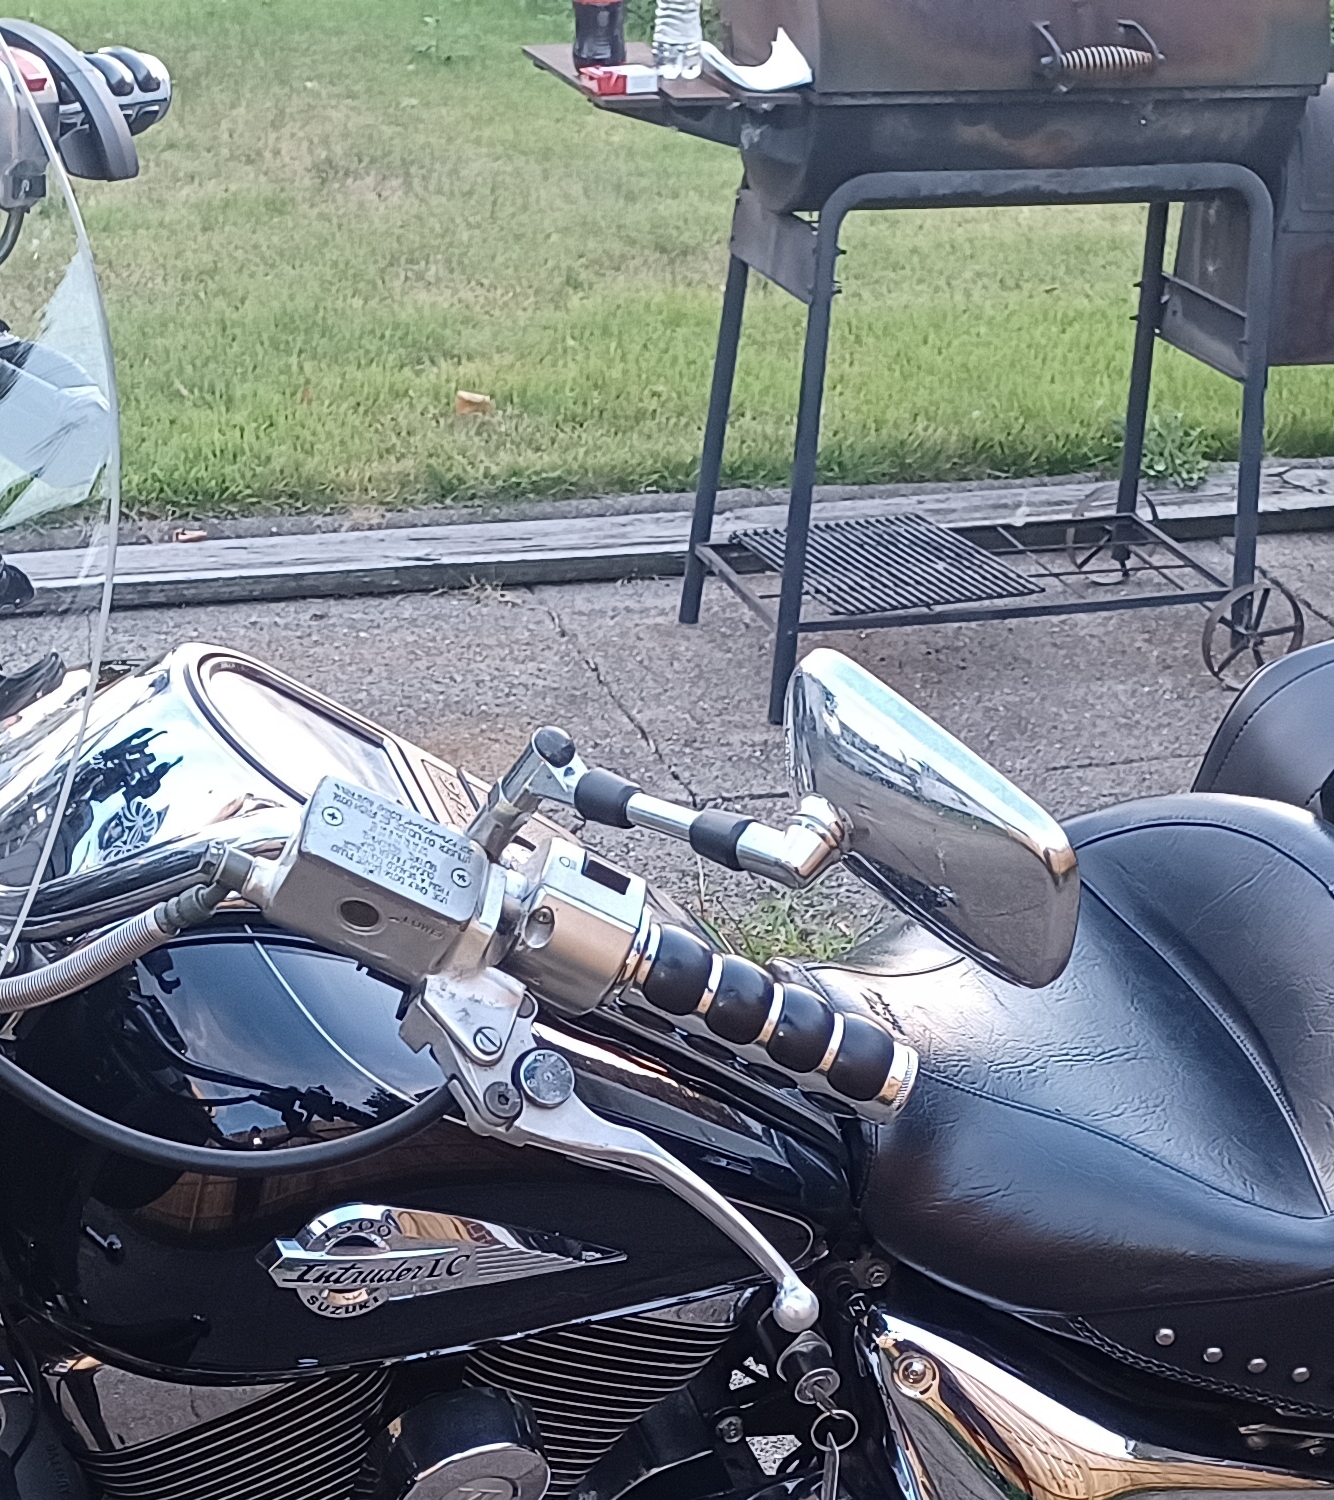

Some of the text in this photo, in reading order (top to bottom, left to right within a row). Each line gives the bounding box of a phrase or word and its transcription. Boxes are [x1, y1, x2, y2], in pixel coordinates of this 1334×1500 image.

[282, 1254, 471, 1284] Intruder LC
[306, 1294, 380, 1316] SUZUKI
